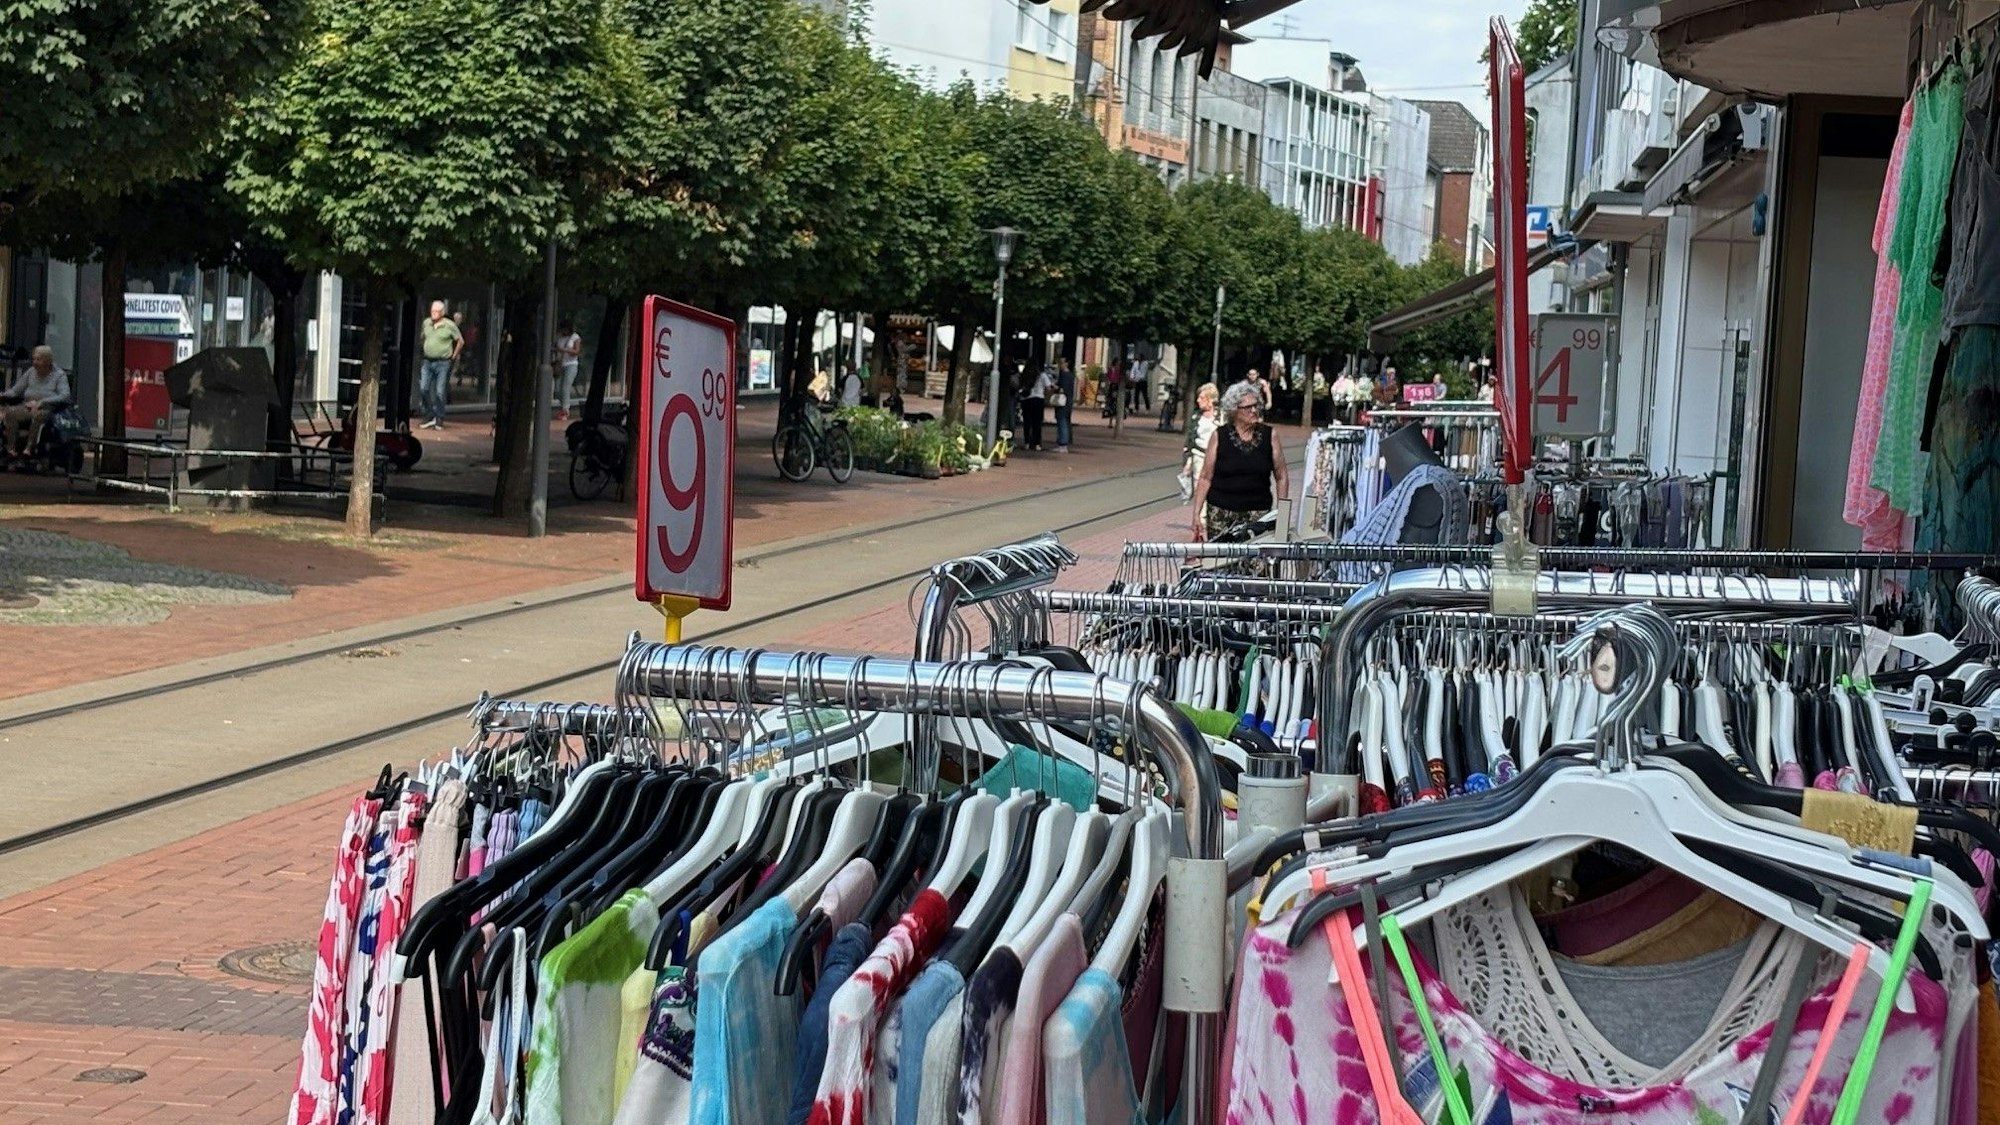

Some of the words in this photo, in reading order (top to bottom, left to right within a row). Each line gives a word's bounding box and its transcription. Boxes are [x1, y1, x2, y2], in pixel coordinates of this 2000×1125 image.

[656, 327, 672, 378] €
[1530, 347, 1578, 423] 4
[1572, 328, 1601, 350] 99
[702, 368, 727, 421] 99
[657, 393, 706, 574] 9
